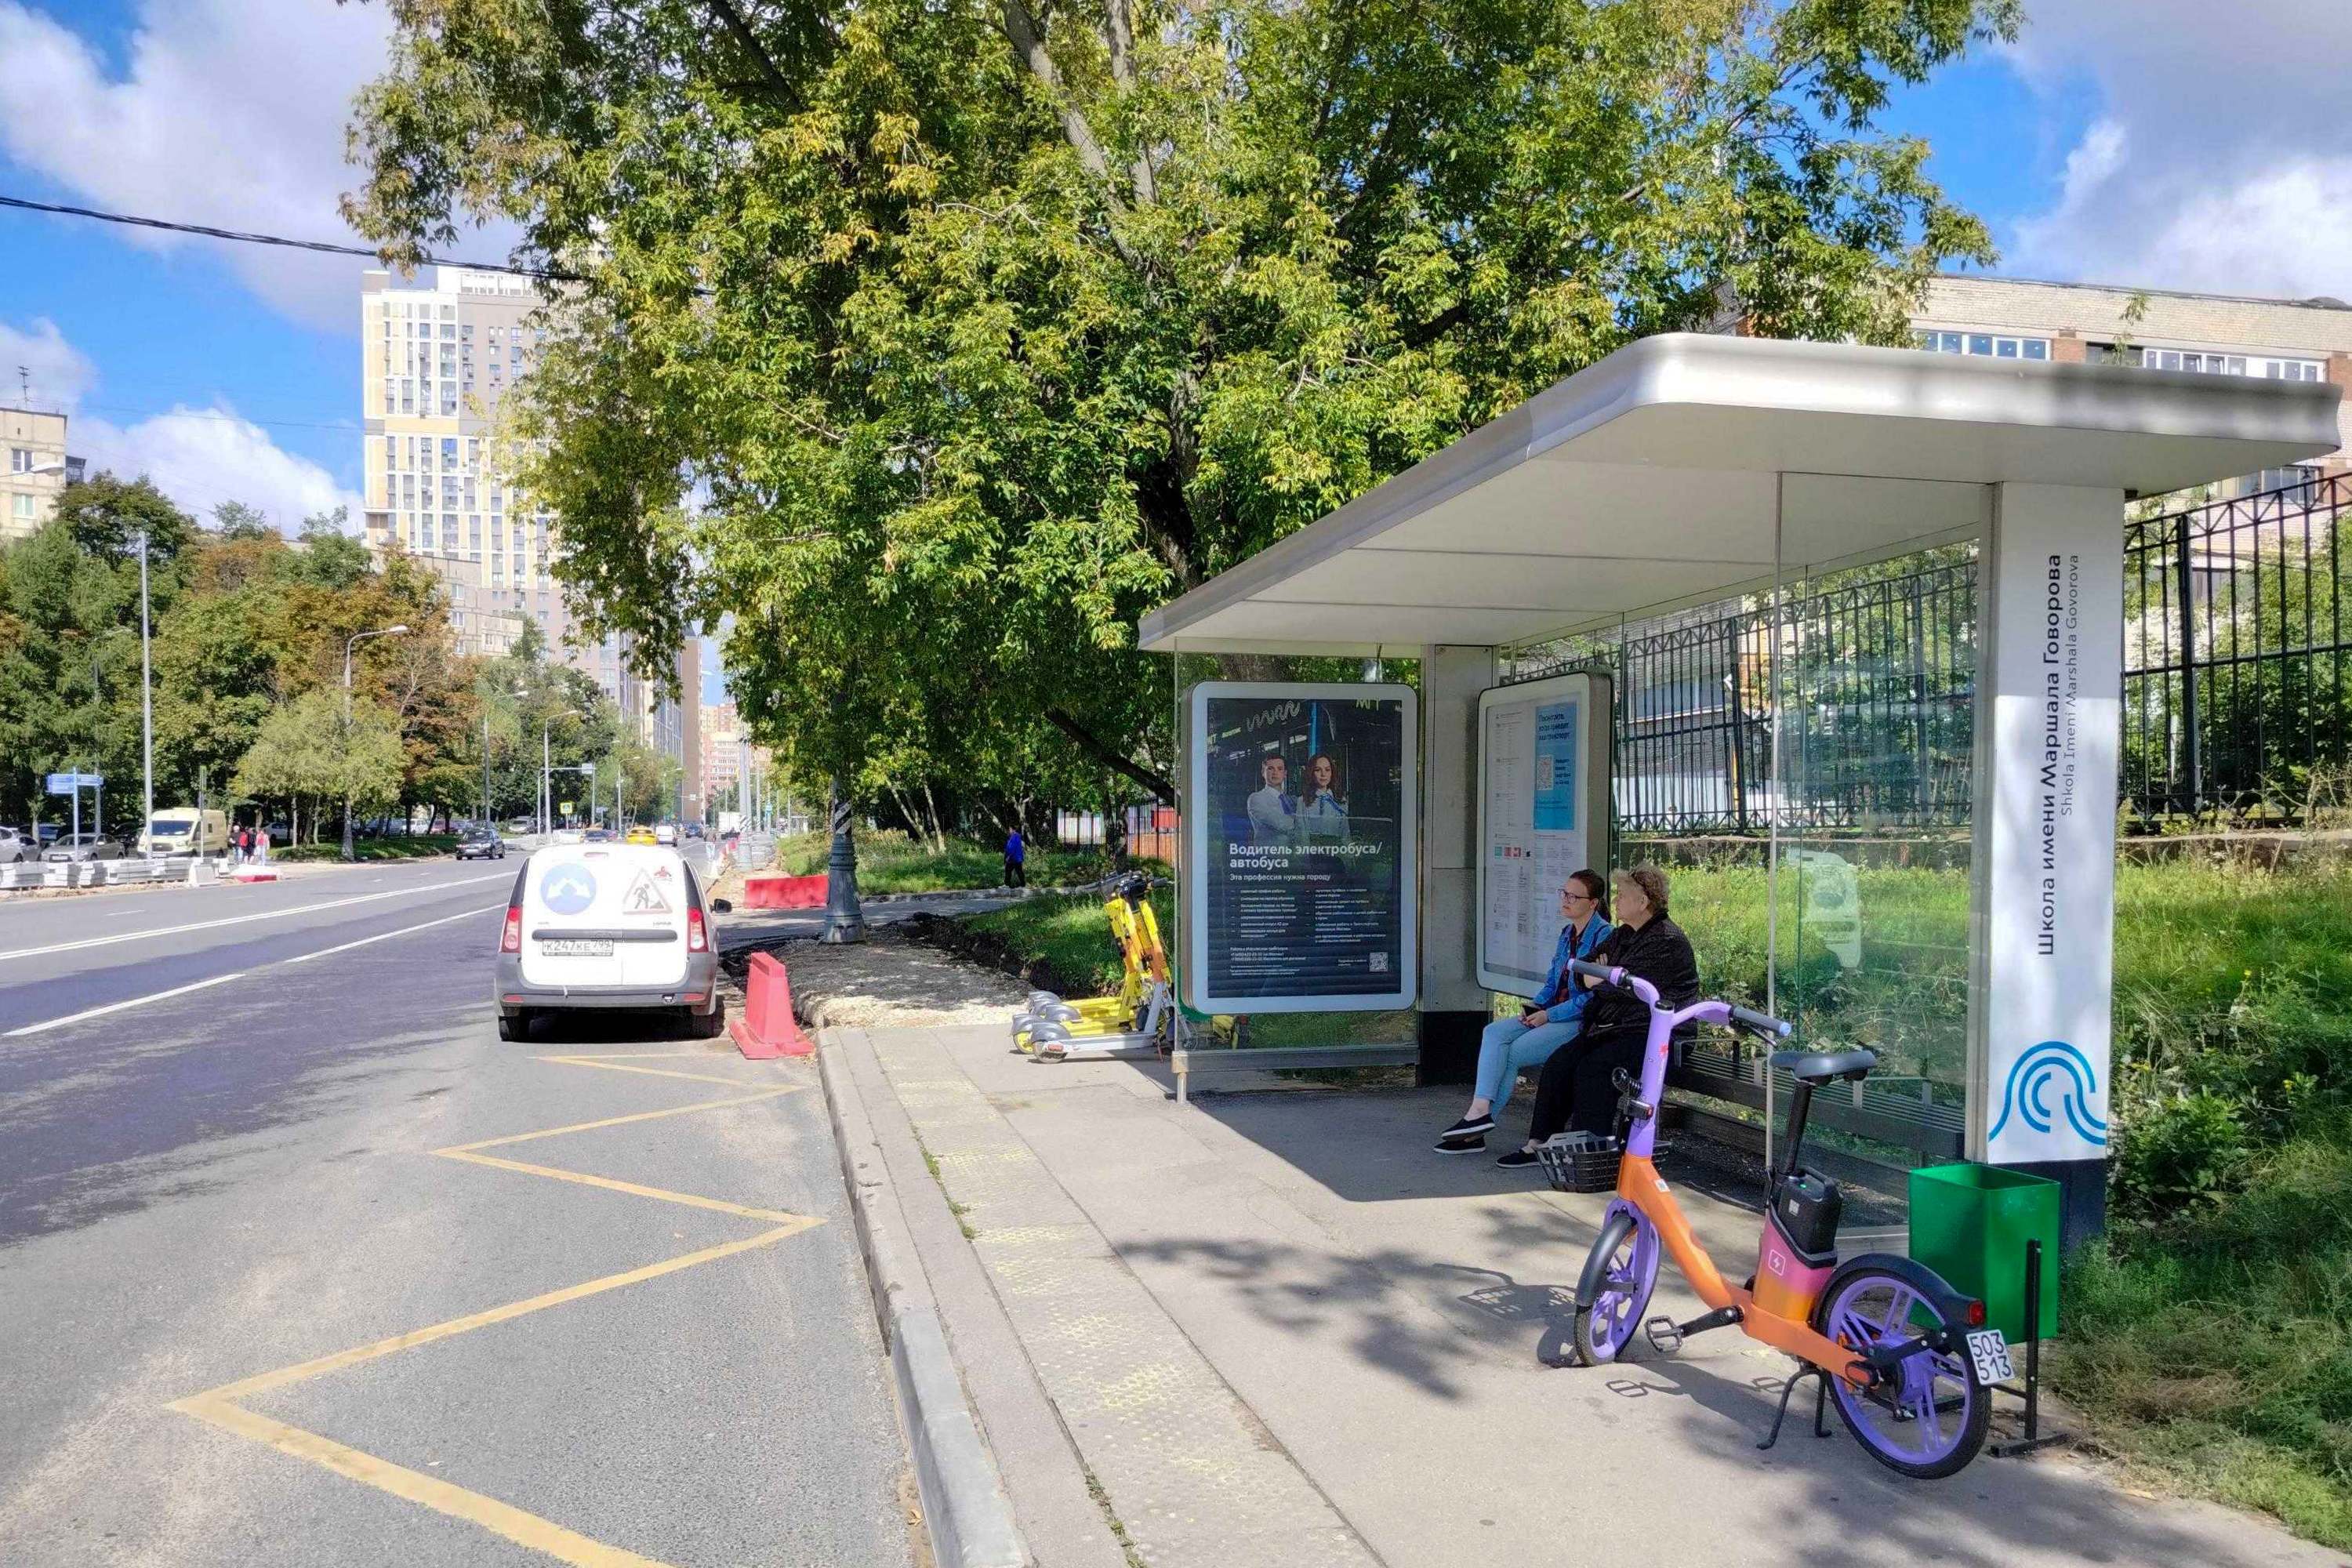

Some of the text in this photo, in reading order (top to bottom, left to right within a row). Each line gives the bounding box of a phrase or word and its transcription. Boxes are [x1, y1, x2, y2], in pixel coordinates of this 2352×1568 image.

[2061, 555, 2078, 815] Shkola Imeni Marshala Govorova
[2038, 555, 2063, 955] Школа имени Маршала Говорова
[1229, 841, 1383, 856] Водитель электробуса/
[1229, 856, 1289, 870] автобуса
[1969, 1332, 2004, 1357] 503
[1977, 1355, 2011, 1381] 513
